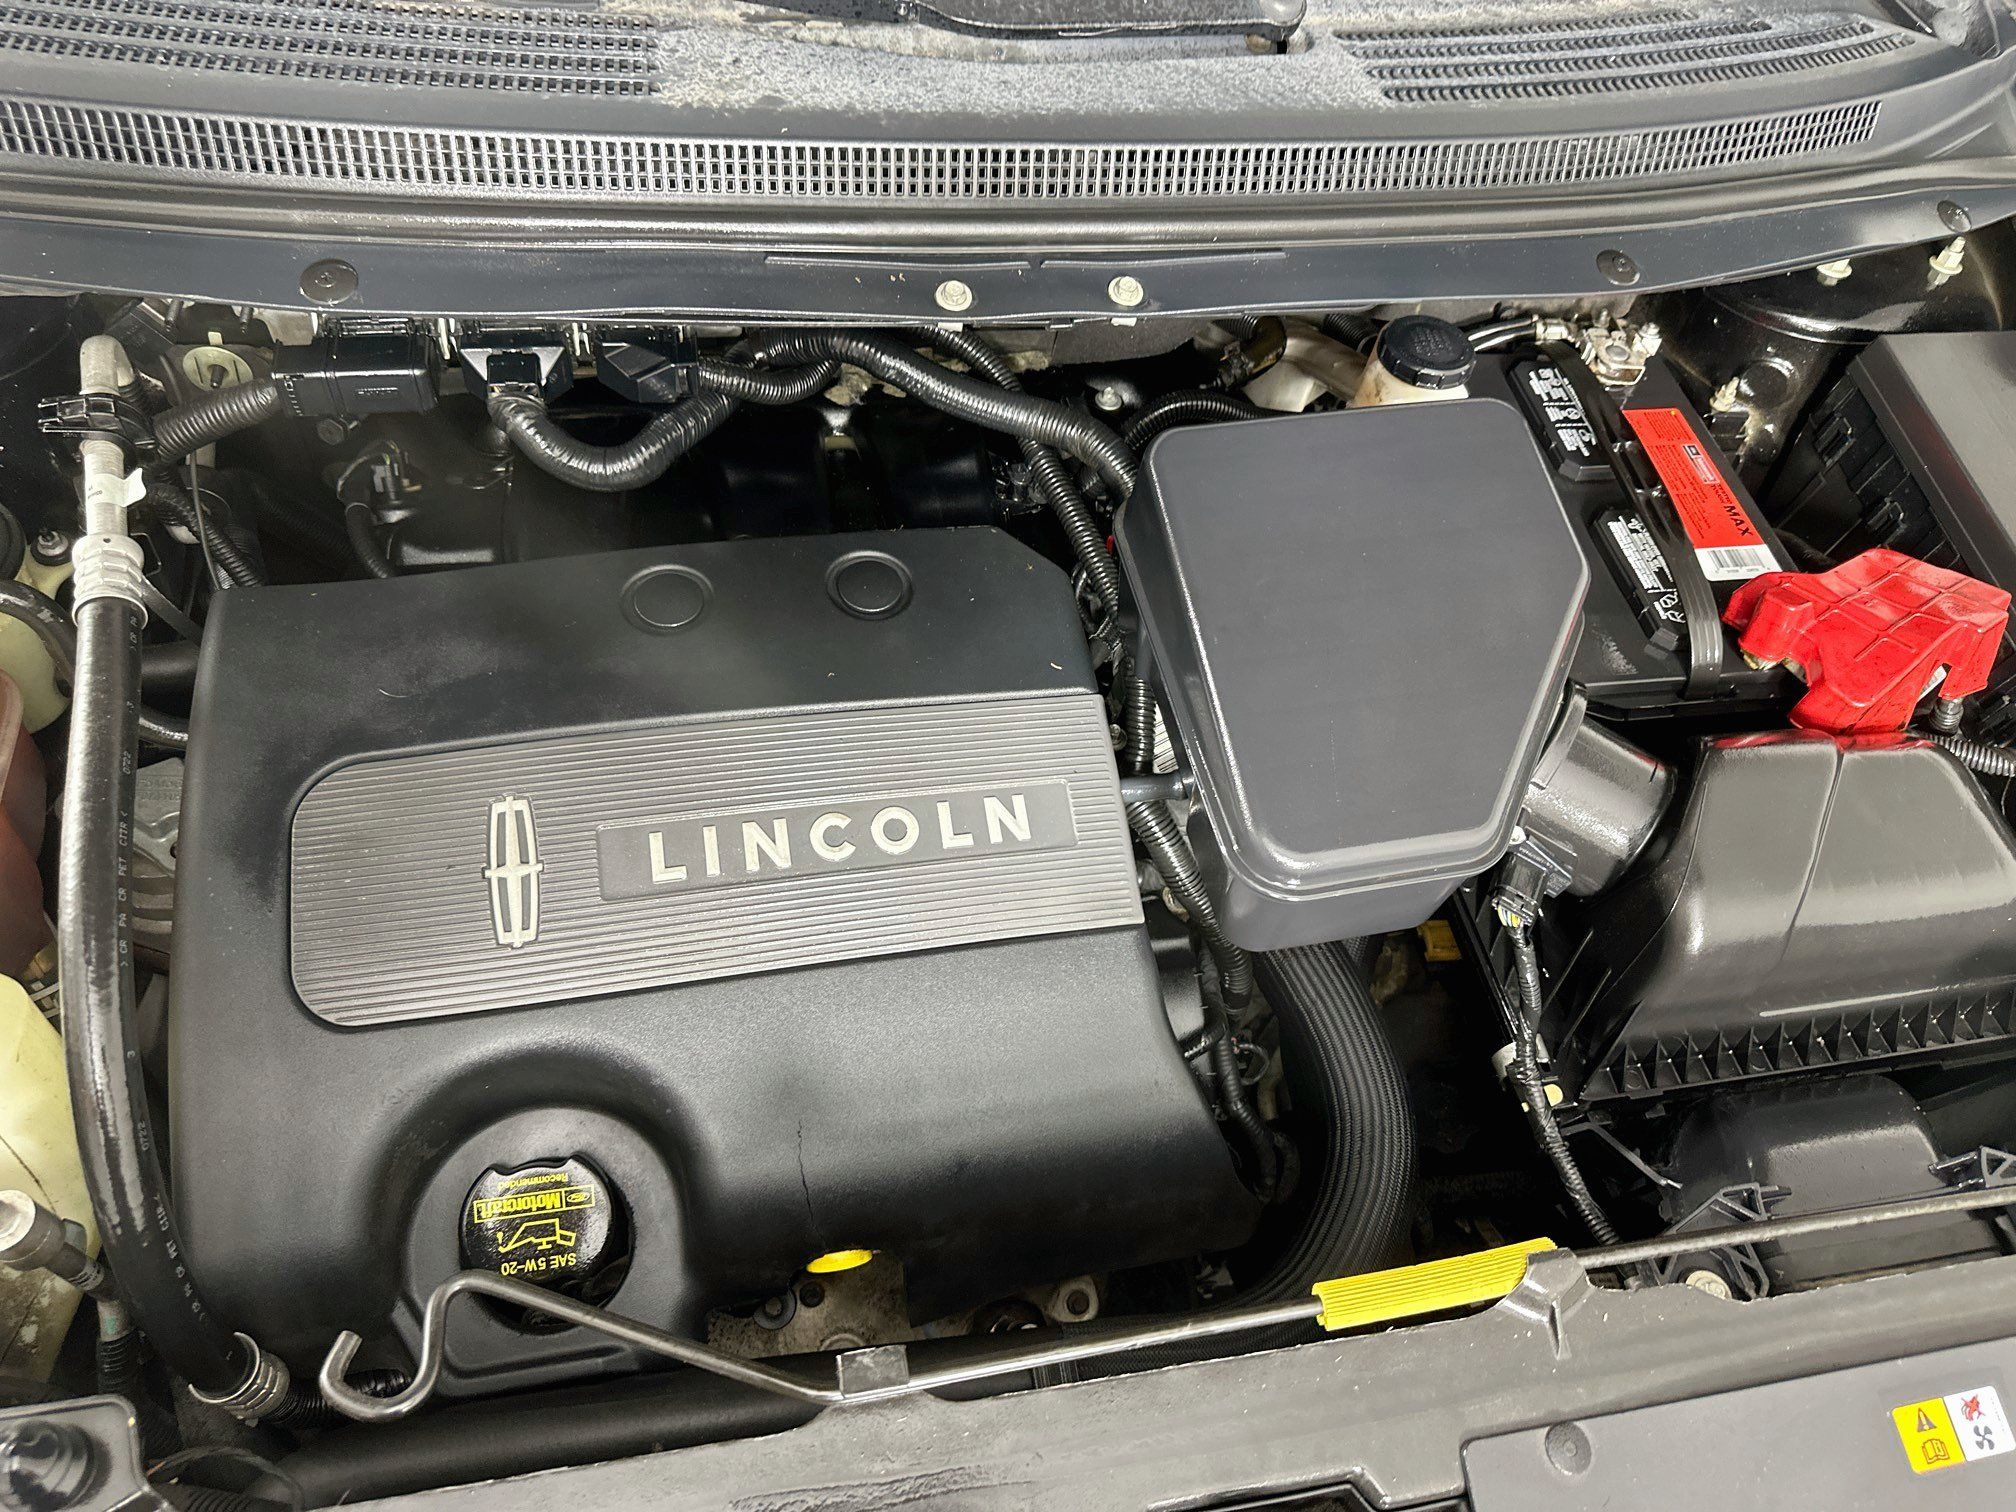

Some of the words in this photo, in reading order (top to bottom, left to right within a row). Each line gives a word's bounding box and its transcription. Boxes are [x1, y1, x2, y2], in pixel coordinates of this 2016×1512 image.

[1723, 505, 1754, 537] MAX
[648, 793, 1033, 885] LINCOLN
[497, 1172, 569, 1191] Recommended
[477, 1192, 561, 1217] Motorcraft
[501, 1258, 547, 1276] 5W-20
[549, 1252, 577, 1269] SAE
